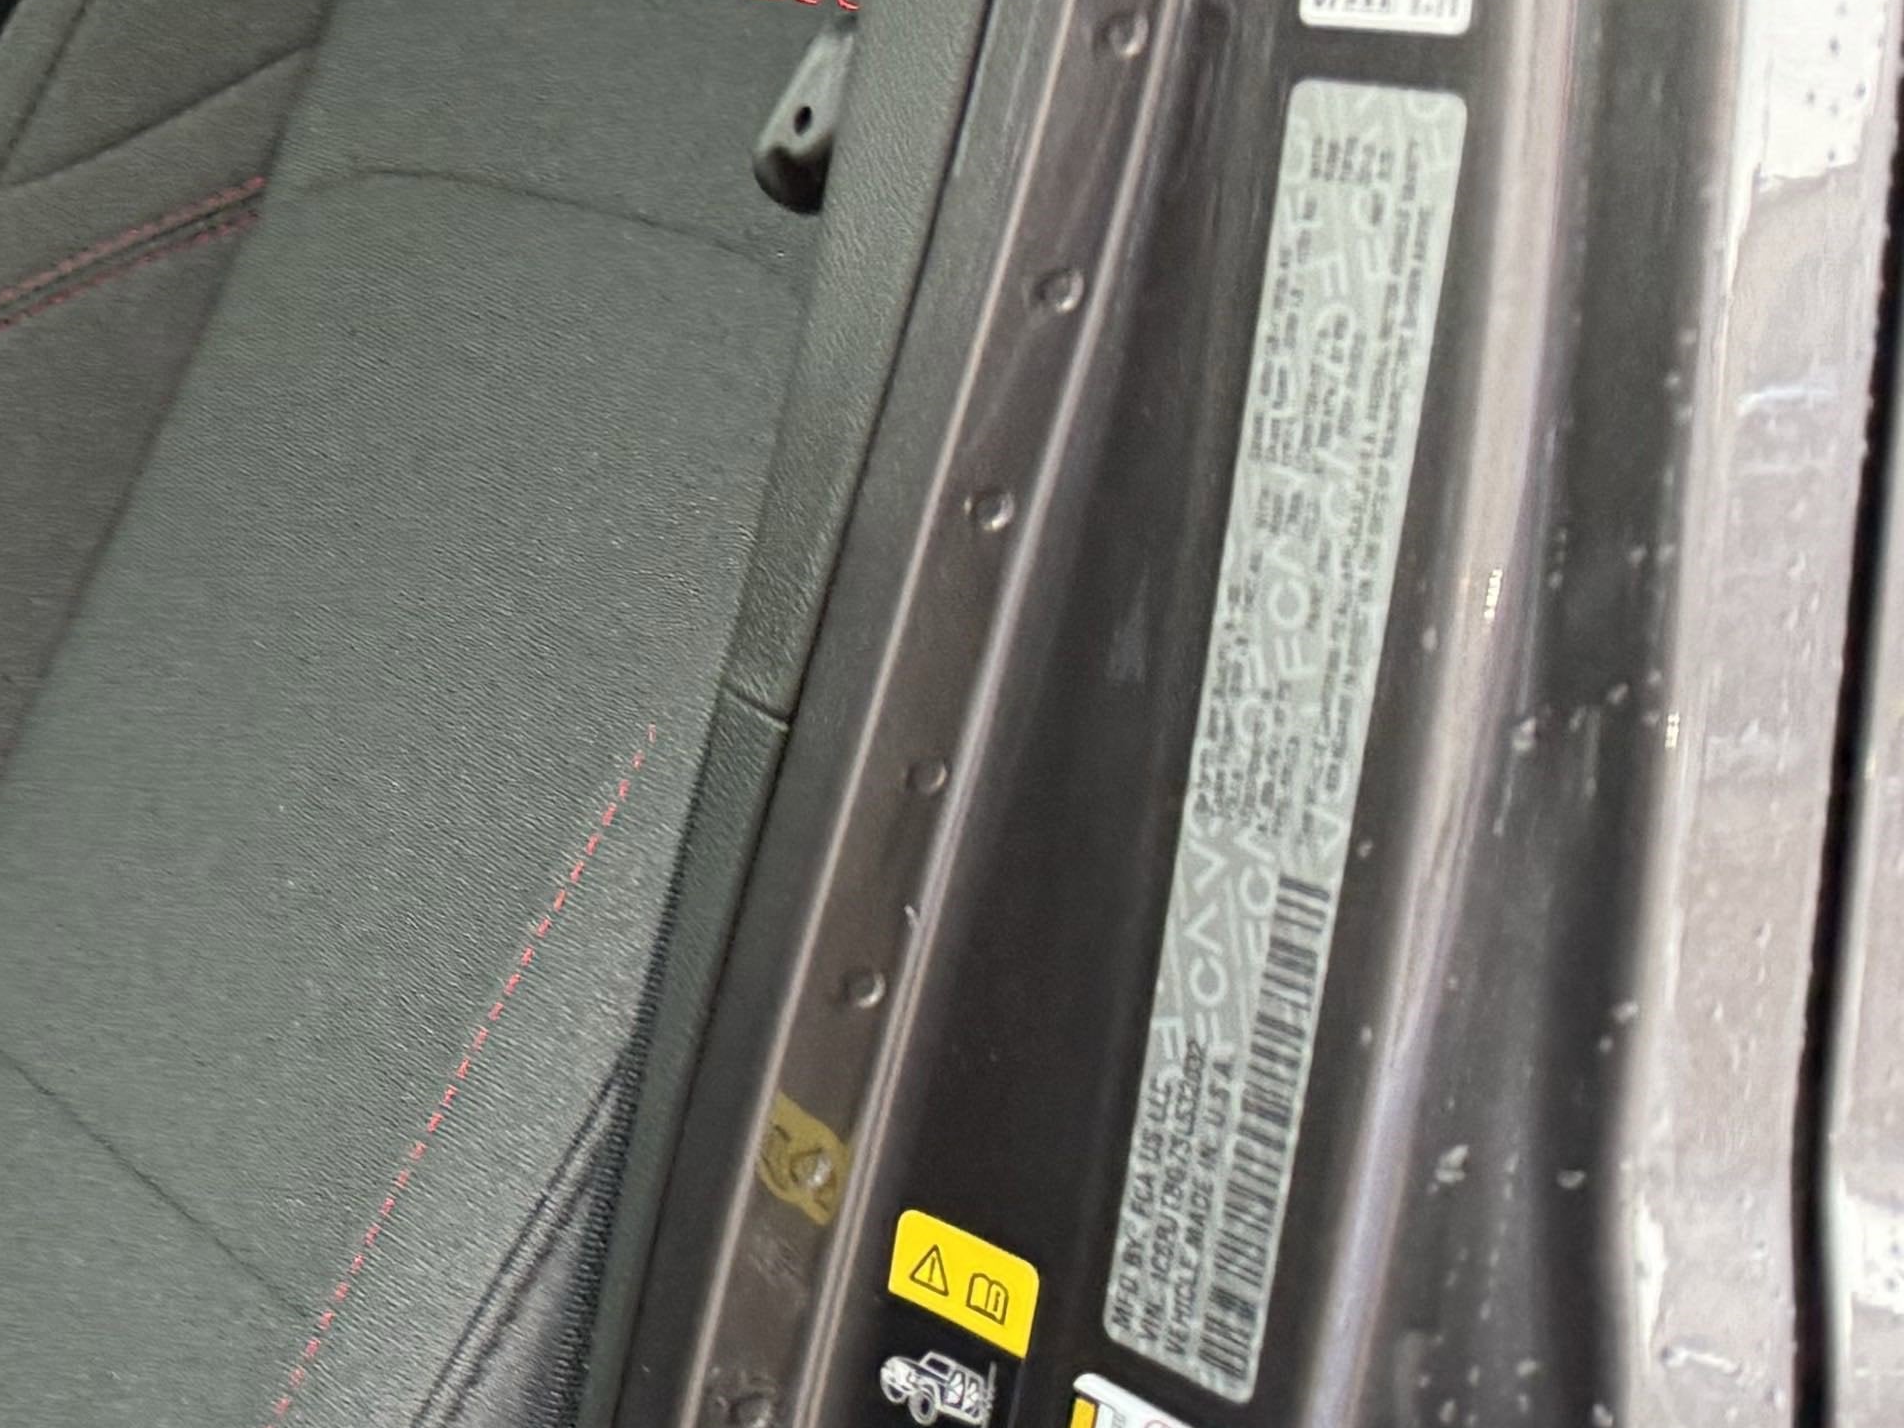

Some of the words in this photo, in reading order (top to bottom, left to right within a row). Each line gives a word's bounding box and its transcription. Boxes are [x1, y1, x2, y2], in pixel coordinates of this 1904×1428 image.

[1138, 1126, 1162, 1164] US
[1129, 1167, 1155, 1219] FCA
[1165, 1254, 1200, 1359] VEHICLE
[1183, 1175, 1213, 1250] MADE
